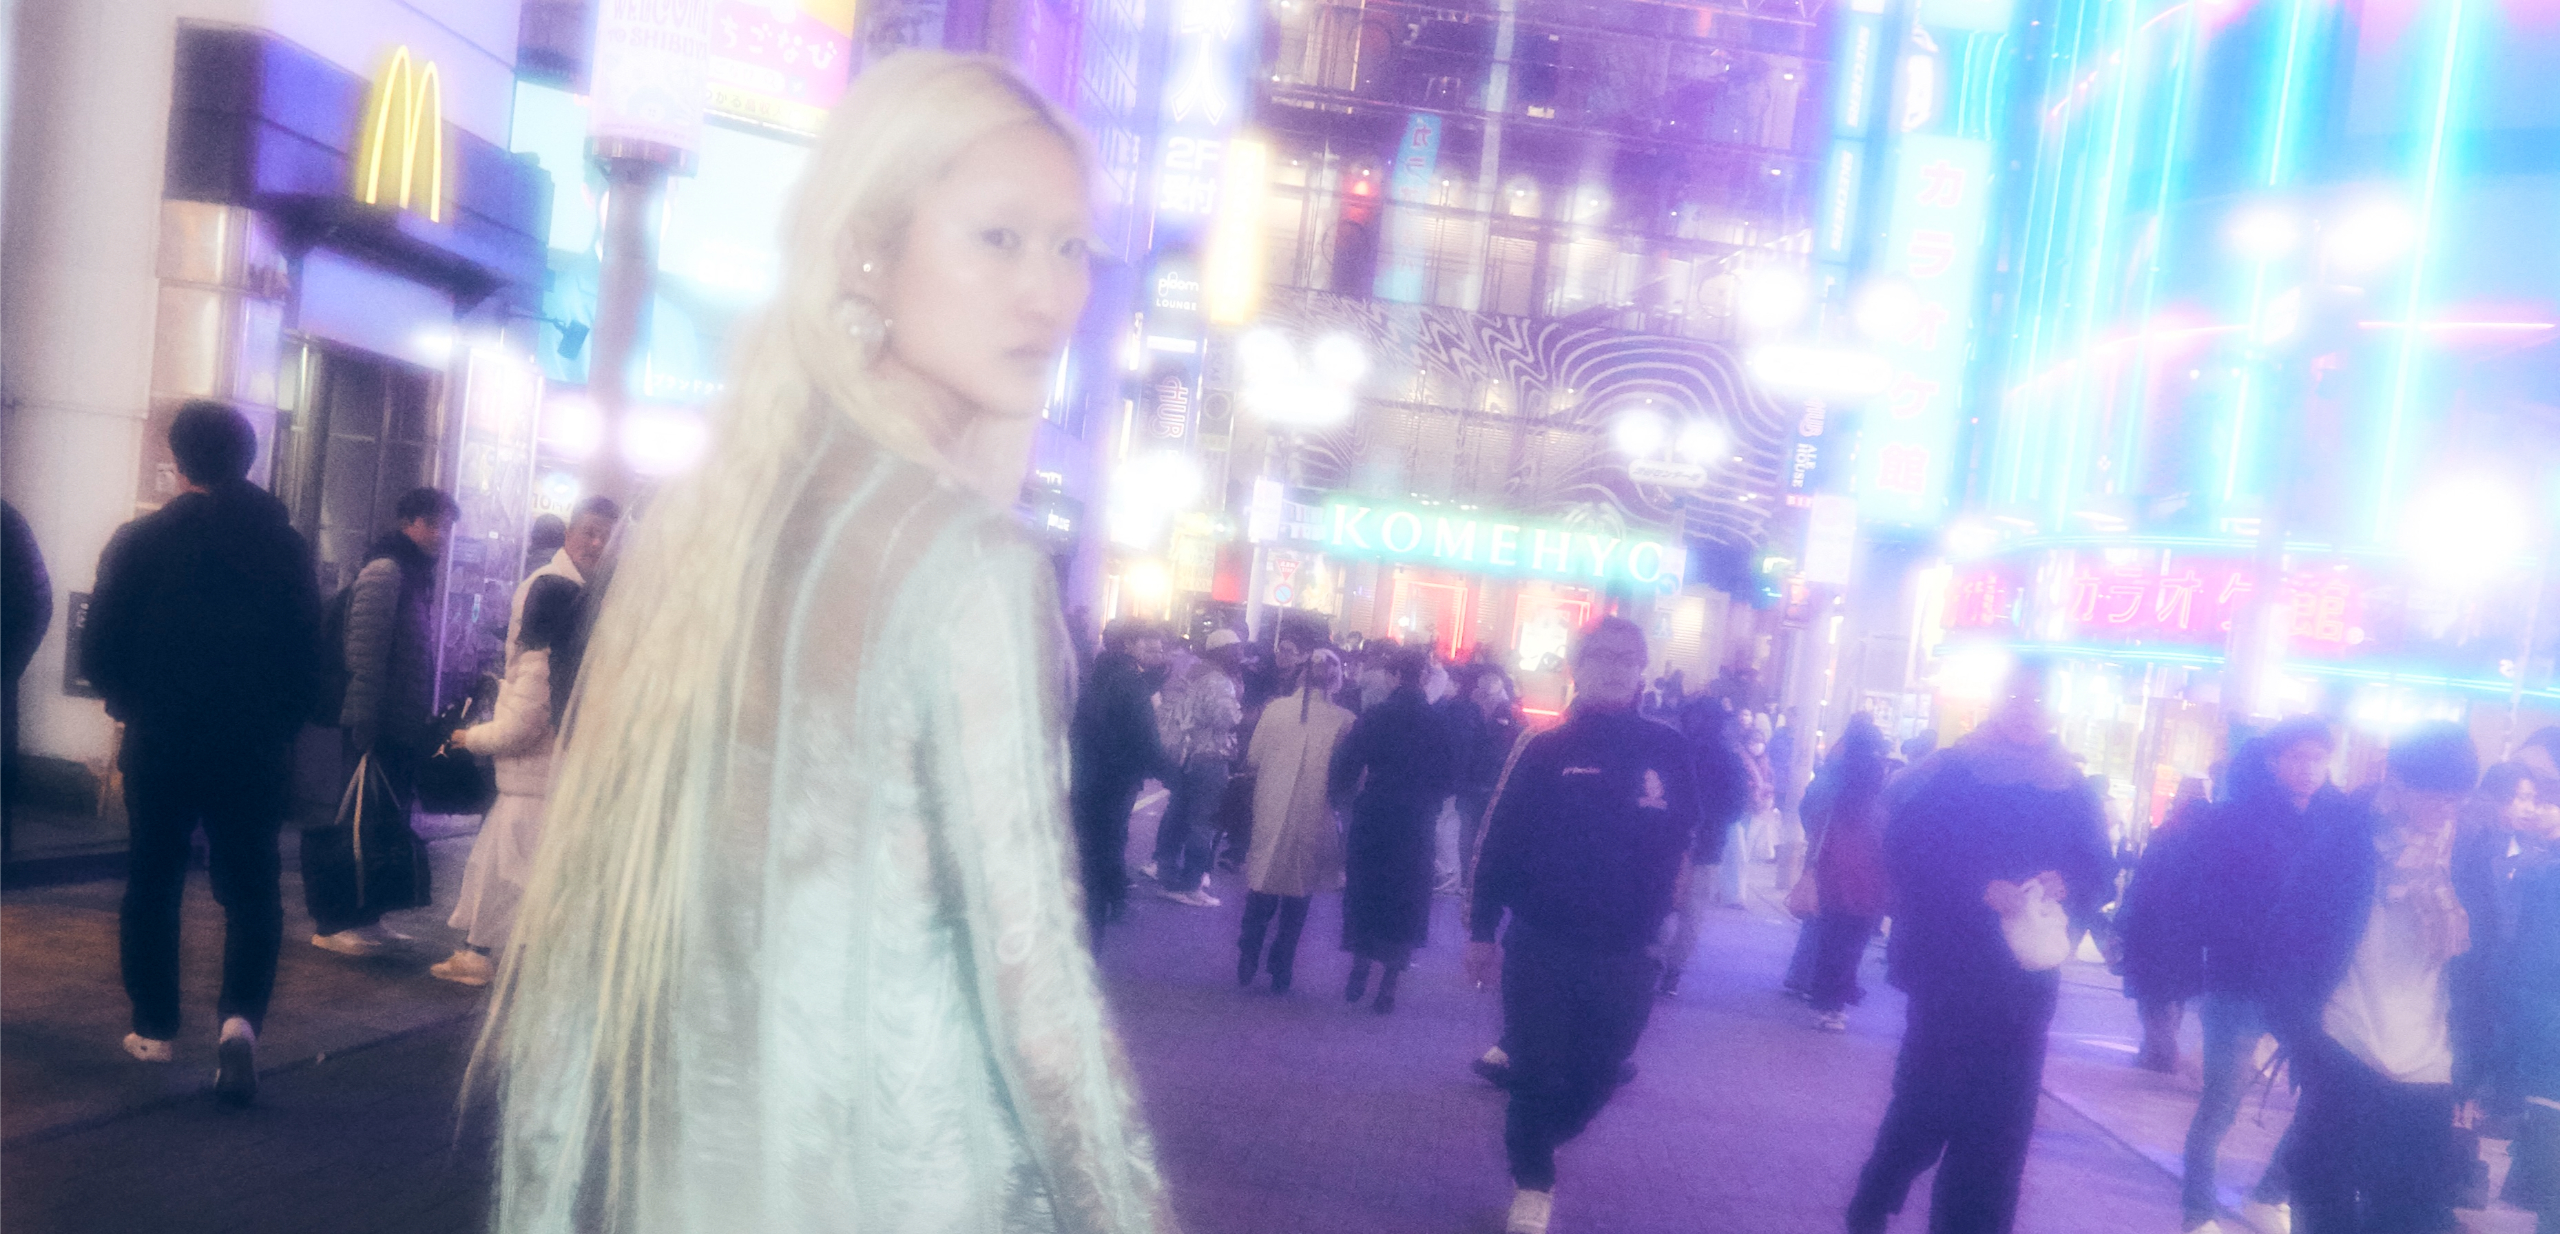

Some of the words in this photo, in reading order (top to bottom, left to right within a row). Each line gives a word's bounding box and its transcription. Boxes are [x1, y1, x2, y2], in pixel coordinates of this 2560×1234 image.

[1165, 136, 1221, 170] 2F
[1160, 173, 1218, 214] 受付
[1156, 298, 1197, 311] LOUNGE
[1877, 160, 1965, 494] カラオケ館
[1149, 376, 1189, 438] HUB
